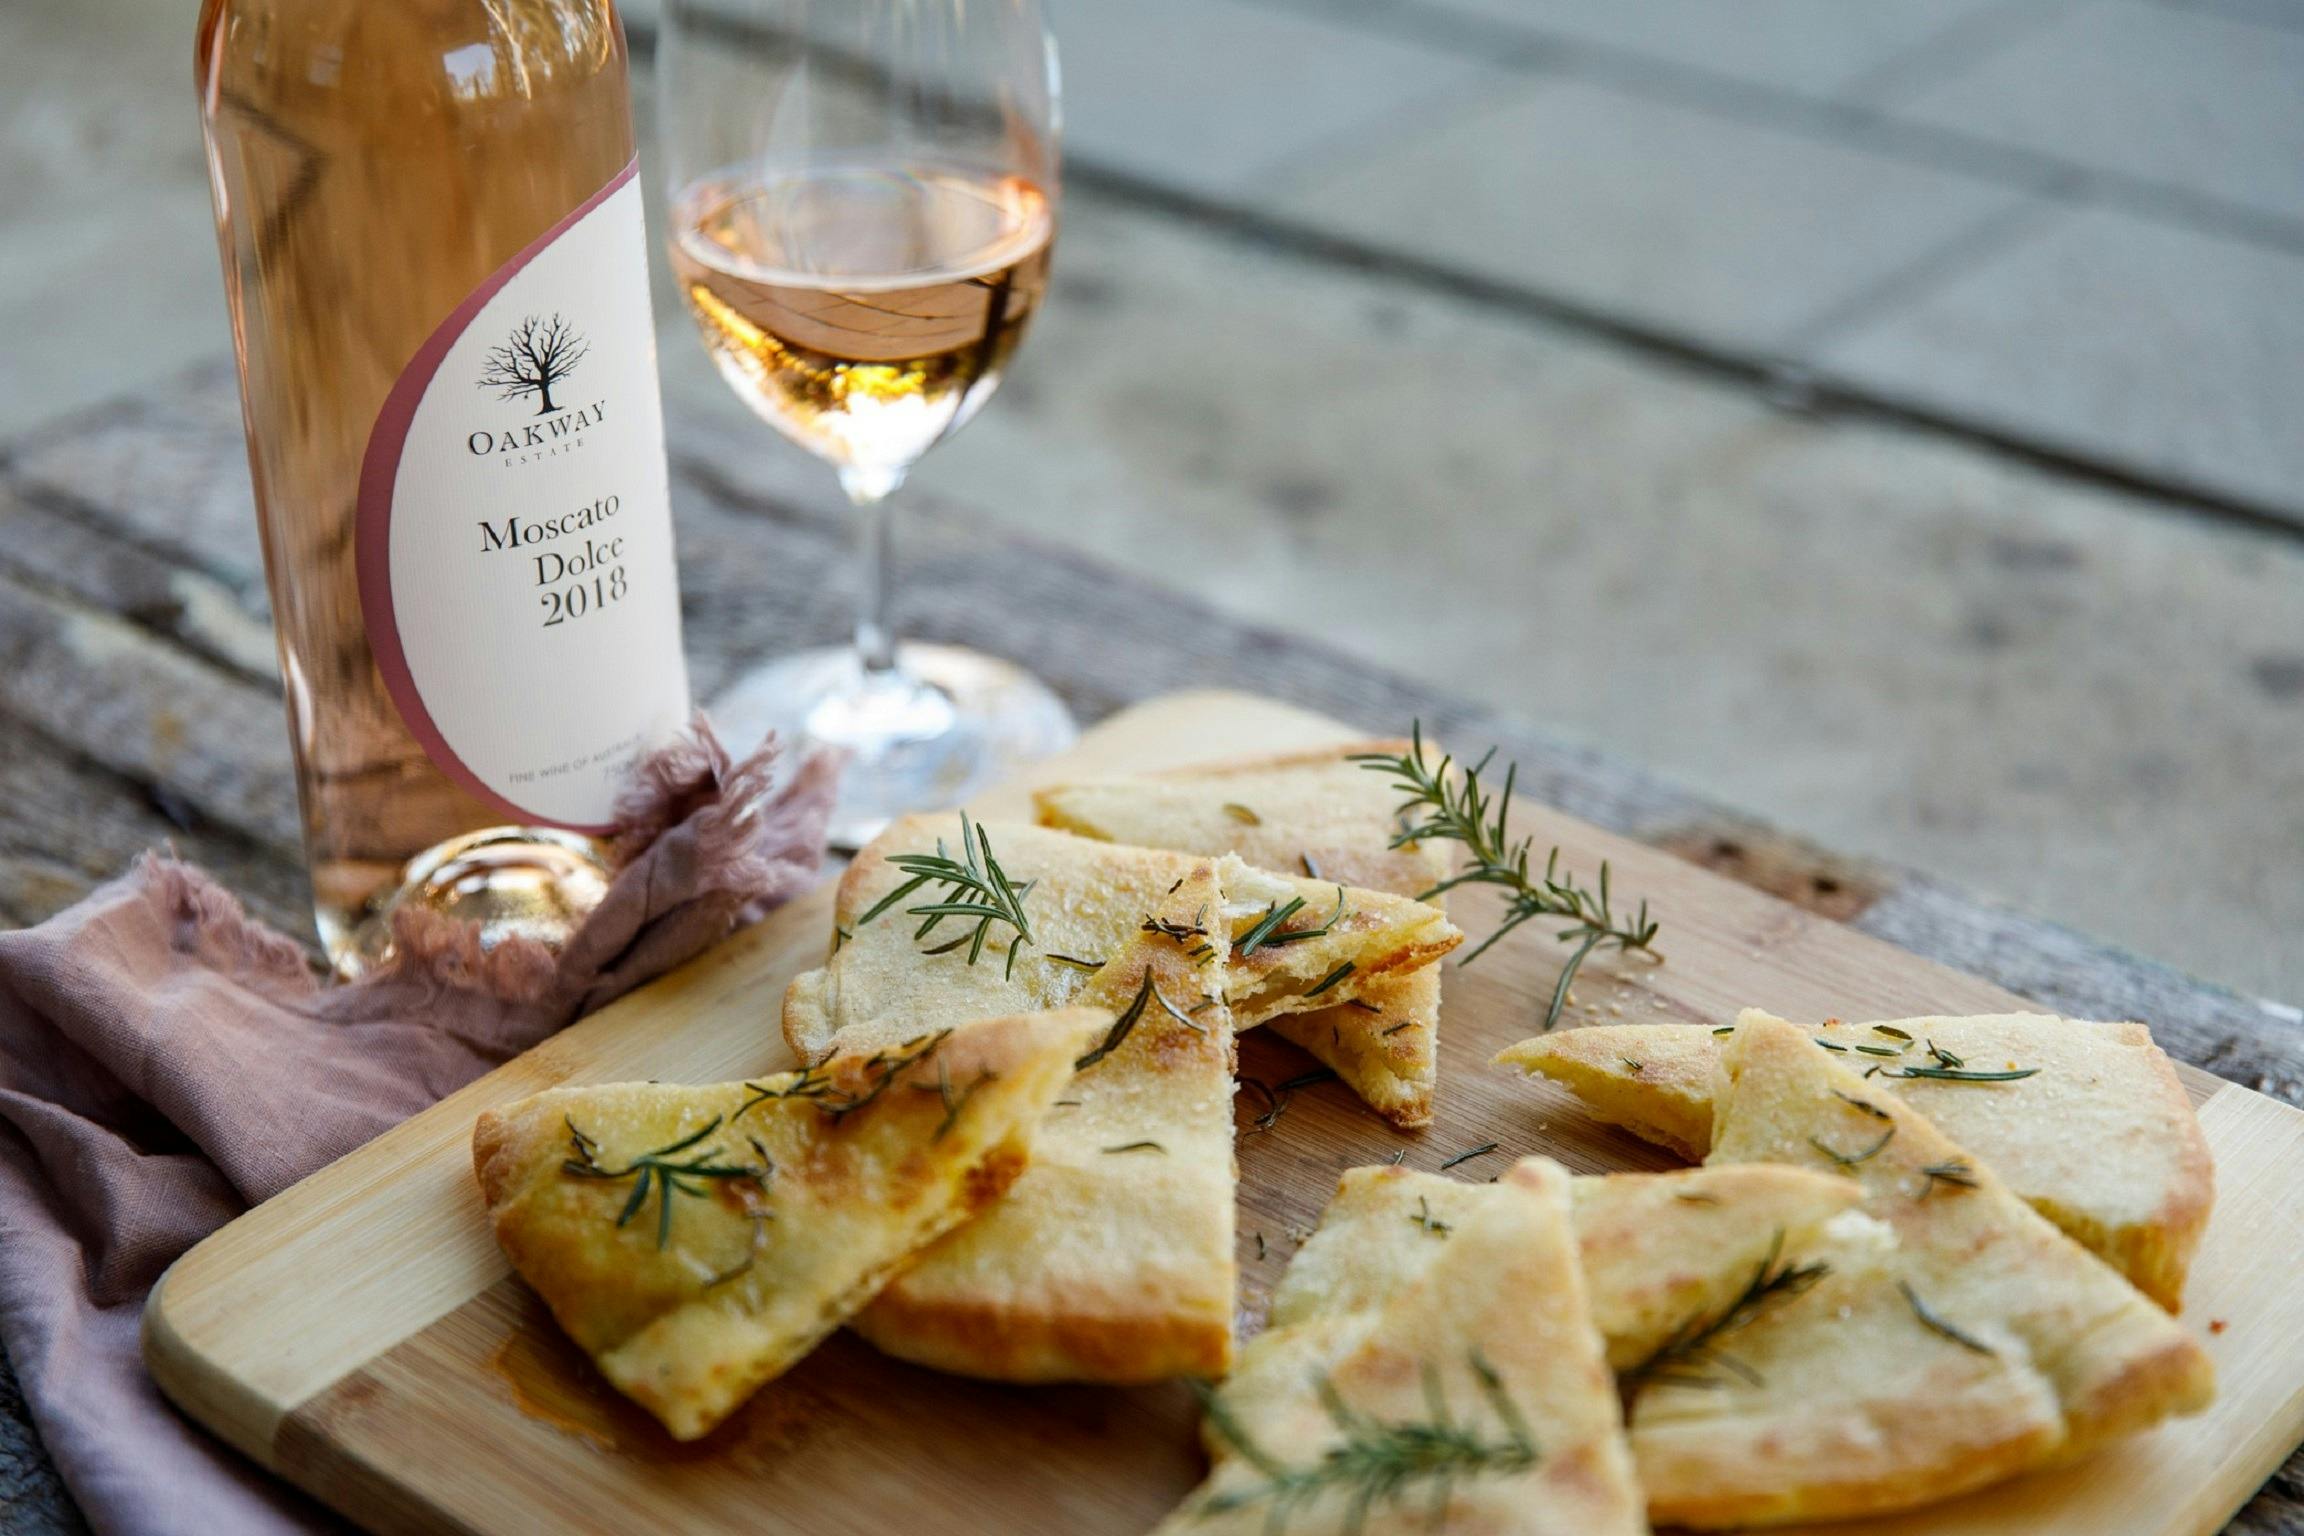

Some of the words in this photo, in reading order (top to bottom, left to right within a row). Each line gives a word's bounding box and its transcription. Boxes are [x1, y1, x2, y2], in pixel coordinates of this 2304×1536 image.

[468, 400, 606, 456] OAKWAY
[505, 437, 584, 467] ESTATE
[477, 495, 620, 552] Moscato
[533, 536, 624, 587] Dolce
[541, 565, 628, 627] 2018
[509, 769, 535, 784] FINE
[539, 762, 570, 778] WINE
[573, 757, 588, 771] OF
